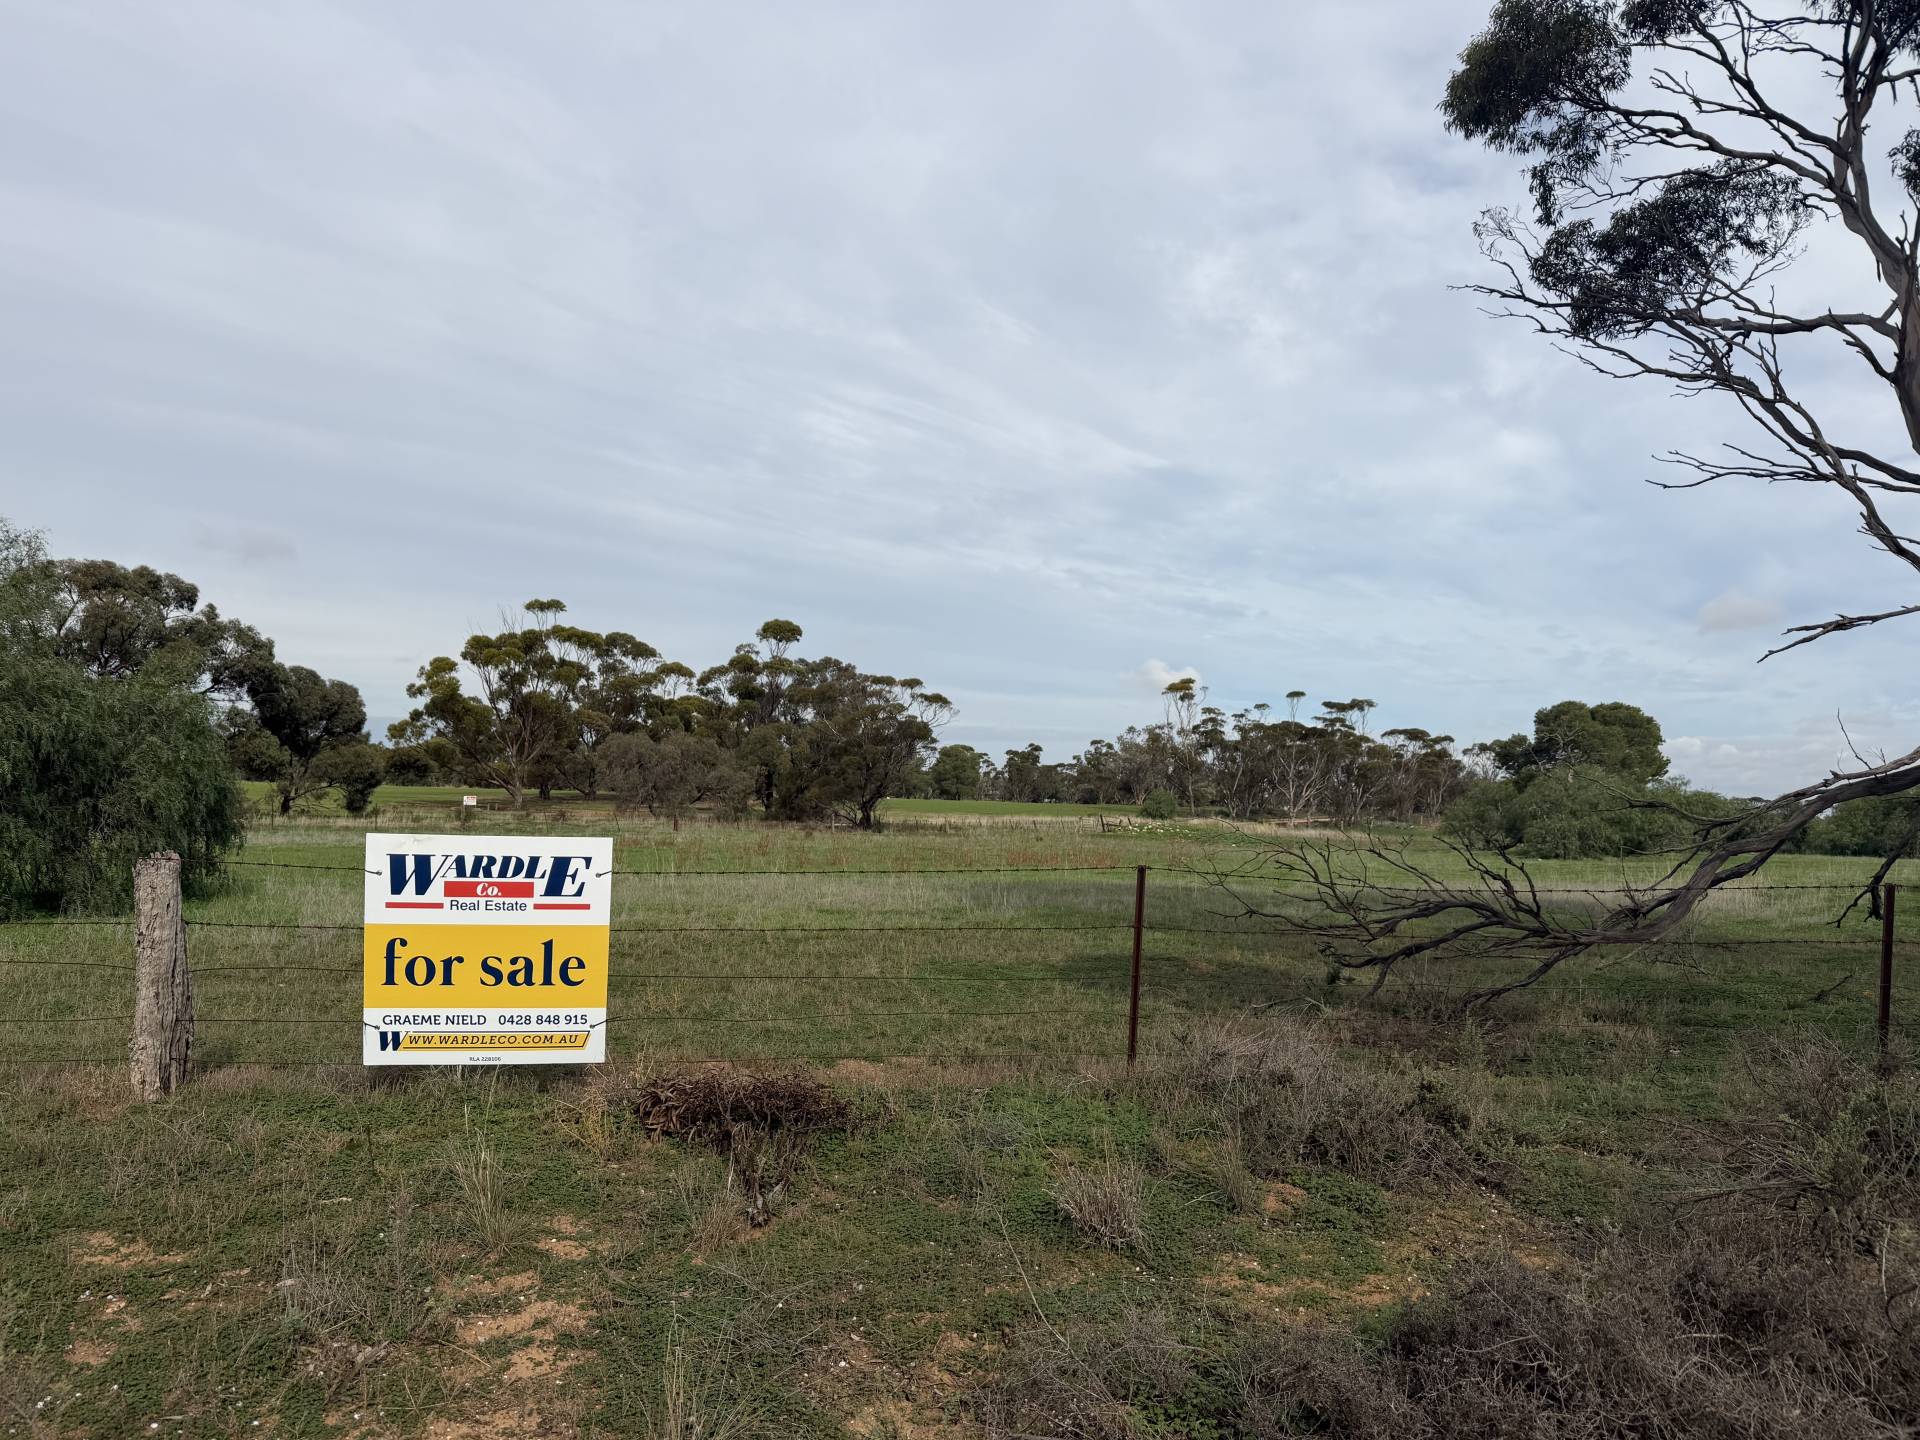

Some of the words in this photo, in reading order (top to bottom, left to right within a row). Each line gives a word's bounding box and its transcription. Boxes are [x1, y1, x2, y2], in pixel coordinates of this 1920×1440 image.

[386, 854, 592, 897] WARDLE
[476, 882, 502, 896] Co.
[450, 900, 480, 911] Real
[485, 900, 527, 911] Estate
[381, 938, 465, 986] for
[479, 938, 586, 987] sale
[382, 1014, 441, 1026] GRAEME
[445, 1014, 487, 1025] NIELD
[498, 1014, 532, 1025] 0428
[536, 1014, 560, 1025] 848
[564, 1014, 588, 1025] 915
